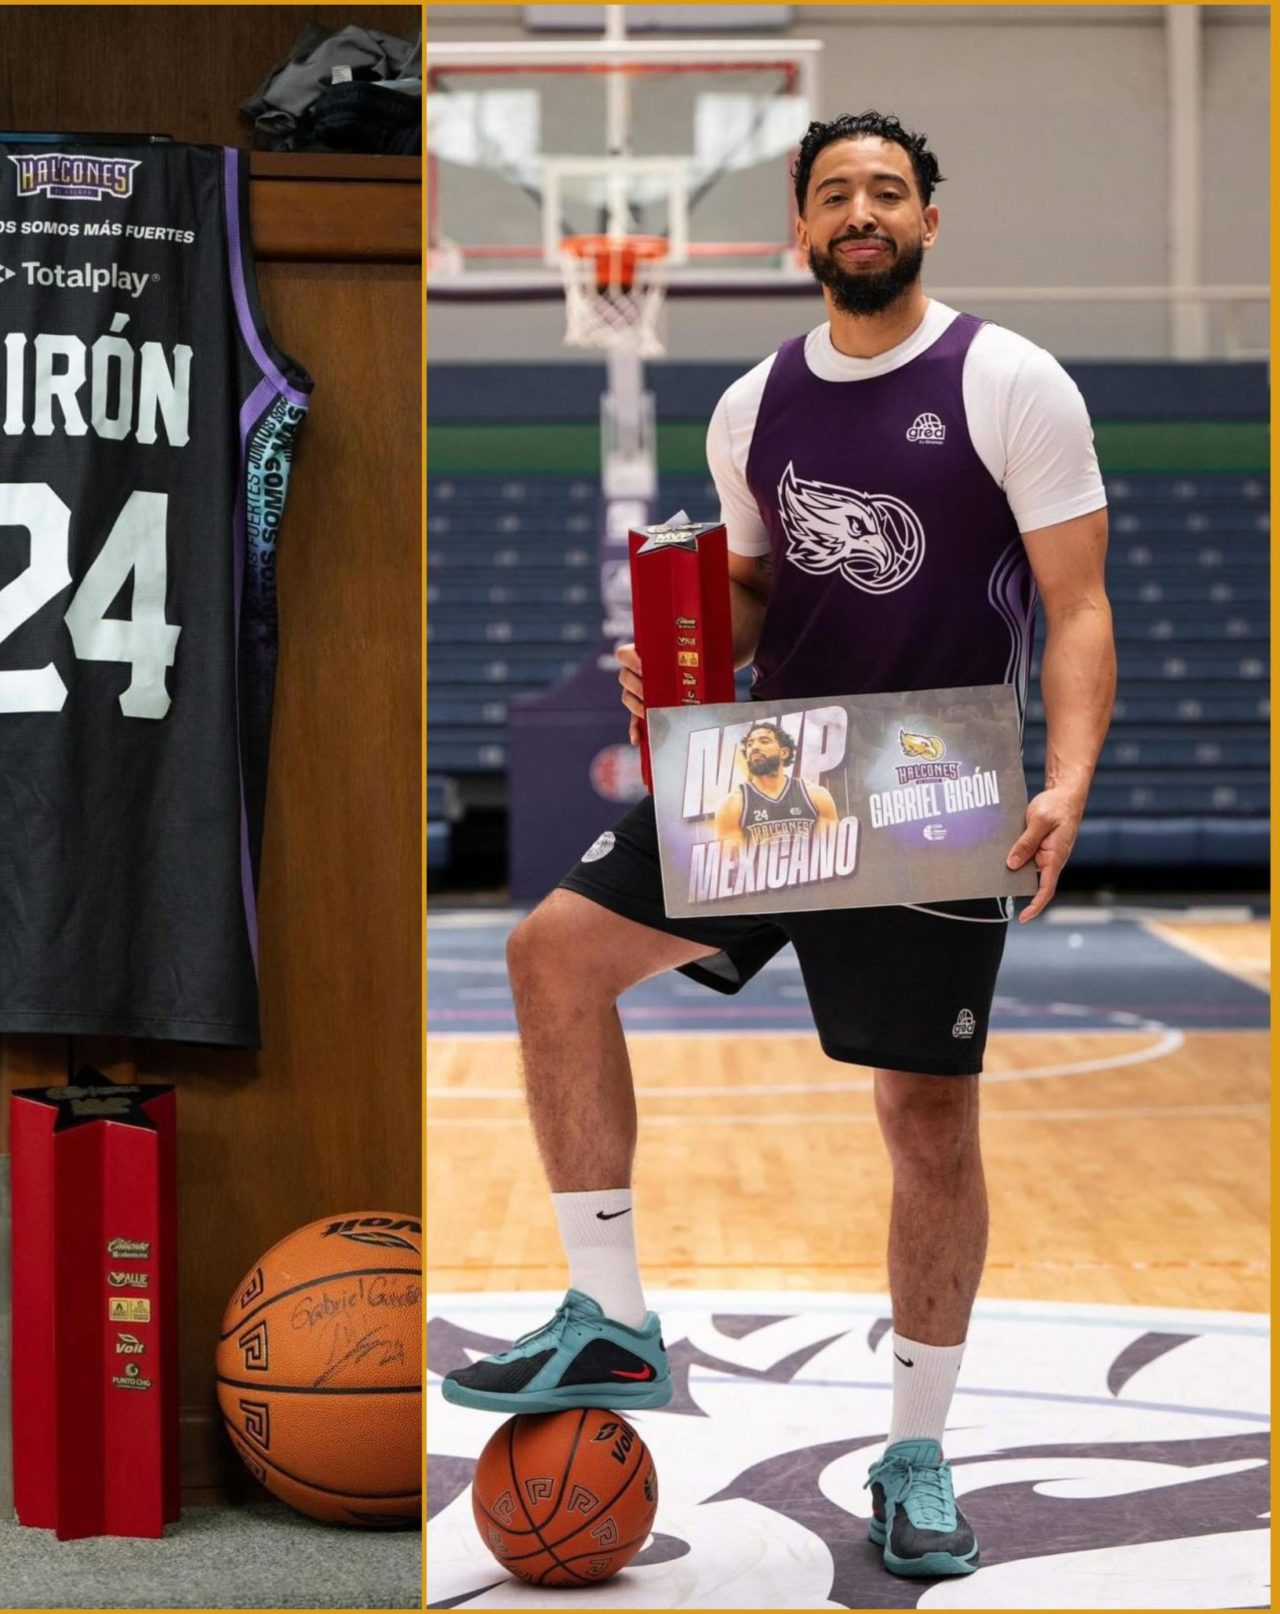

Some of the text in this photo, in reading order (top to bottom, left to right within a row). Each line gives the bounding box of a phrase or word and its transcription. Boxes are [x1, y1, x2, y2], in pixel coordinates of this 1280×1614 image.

[19, 157, 130, 195] HALCONES
[21, 221, 80, 236] SOMOS
[83, 219, 123, 236] MÁS
[125, 225, 195, 244] FUERTES
[248, 420, 277, 470] JUNTOS
[897, 762, 959, 785] HALCONES
[869, 766, 1000, 829] GABRIEL GIRÓN
[754, 808, 769, 821] 24
[688, 816, 860, 904] MEXICANO
[115, 1343, 145, 1354] Voit
[112, 1376, 135, 1386] PUNTO
